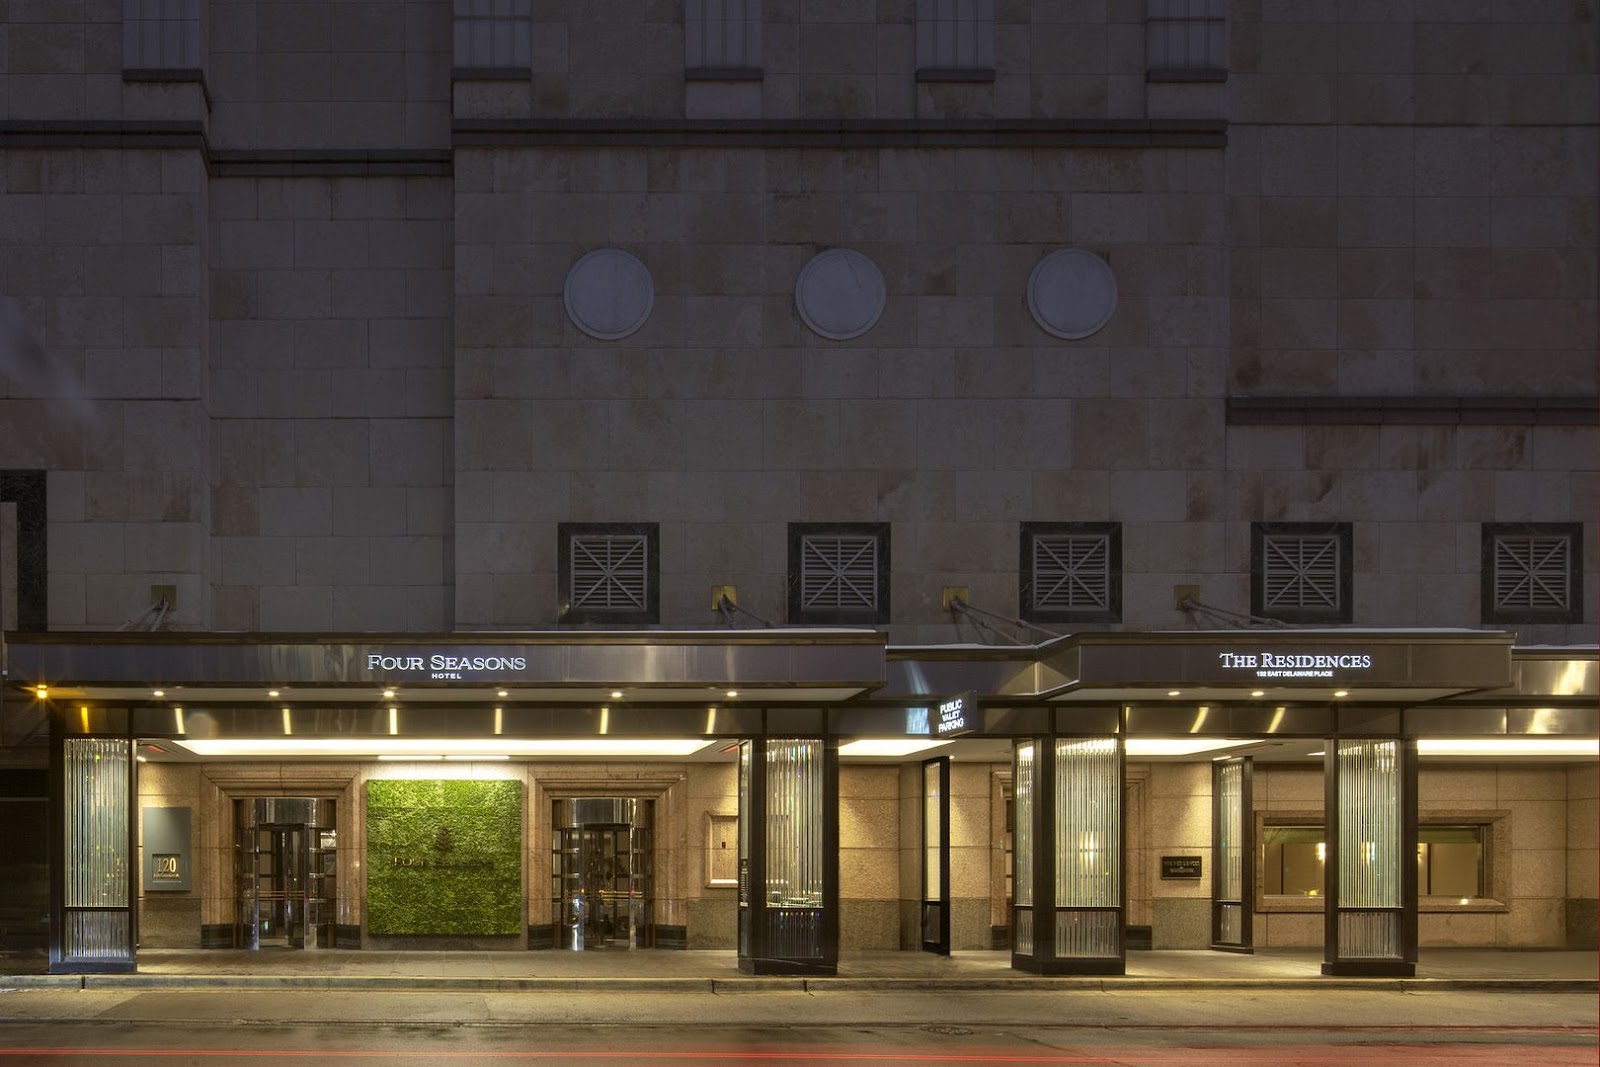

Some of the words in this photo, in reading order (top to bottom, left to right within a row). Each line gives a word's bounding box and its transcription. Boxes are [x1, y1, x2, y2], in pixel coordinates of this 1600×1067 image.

[367, 654, 424, 671] FOUR
[430, 654, 527, 671] SEASONS
[1219, 652, 1257, 668] THE
[1261, 652, 1371, 668] RESIDENCES
[940, 699, 962, 714] PUBLIC
[942, 710, 960, 722] VALET
[938, 718, 964, 733] PARKING
[157, 857, 177, 873] 120
